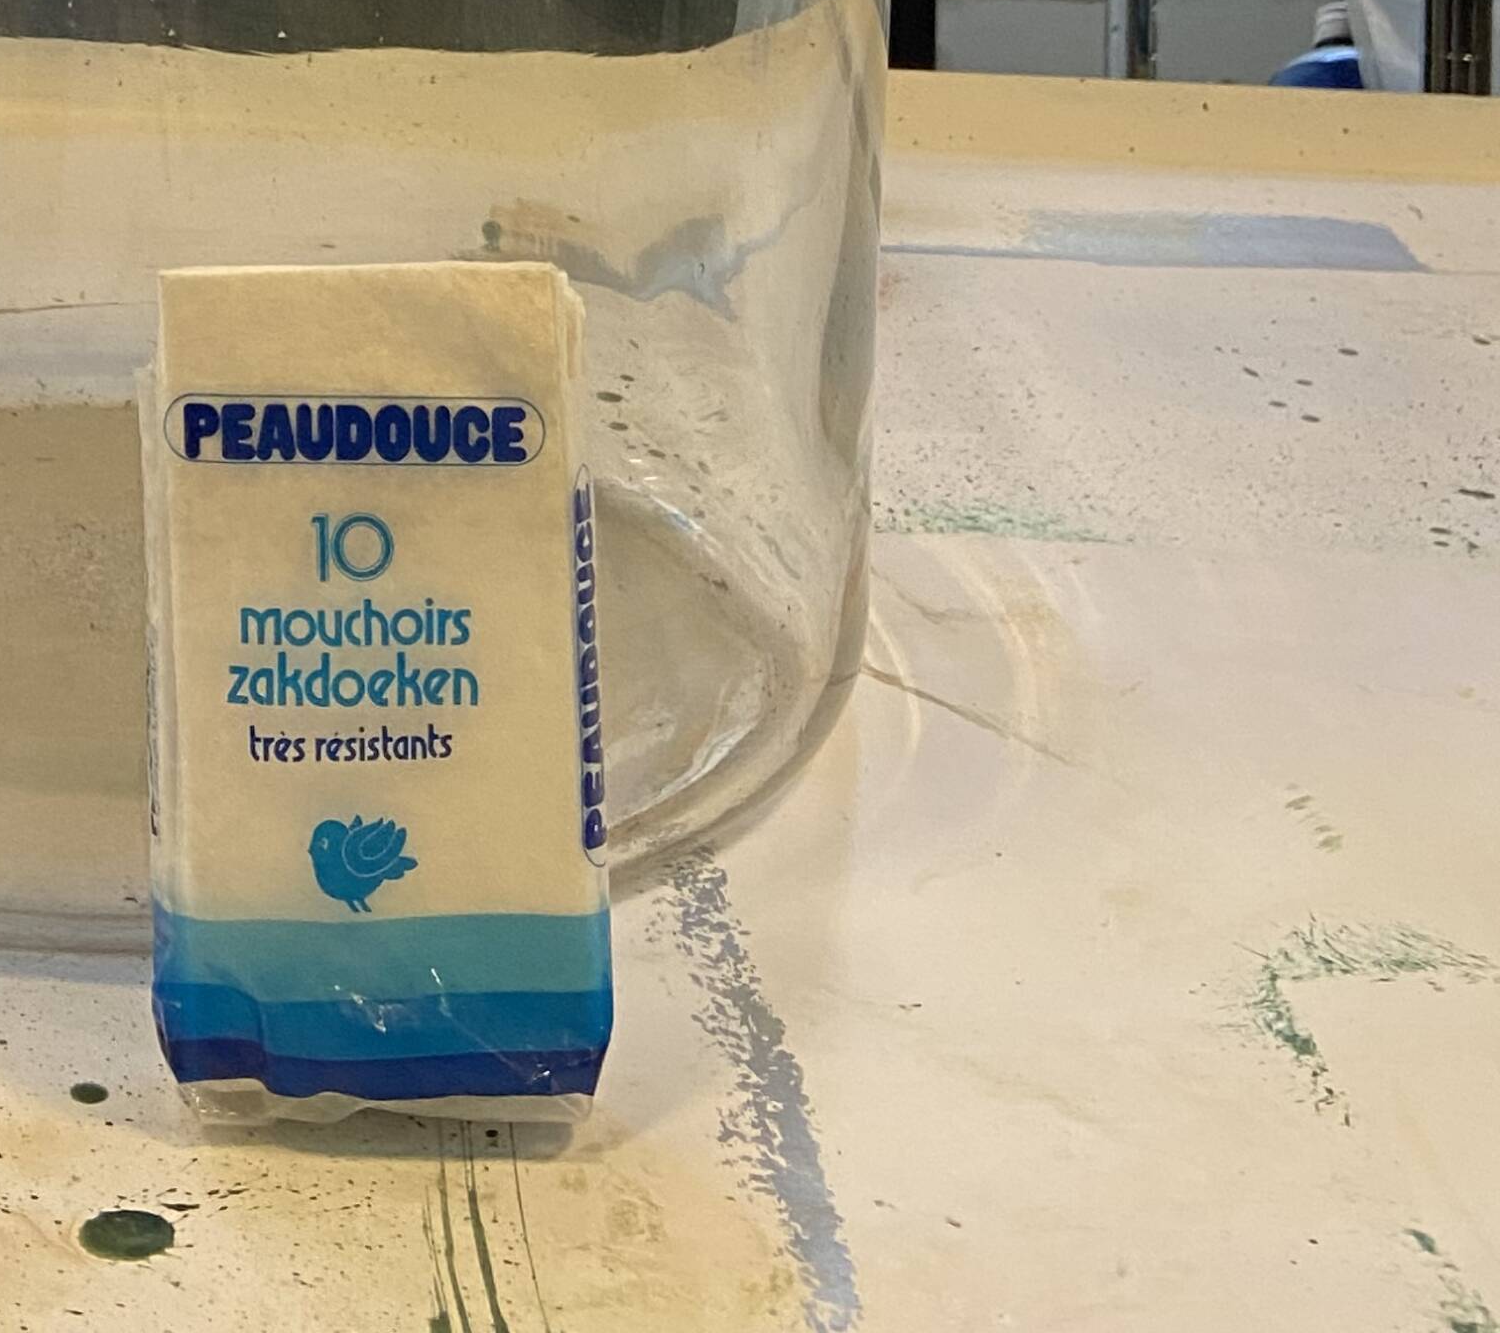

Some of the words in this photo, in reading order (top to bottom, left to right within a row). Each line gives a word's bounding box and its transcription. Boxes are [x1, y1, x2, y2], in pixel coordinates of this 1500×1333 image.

[183, 402, 528, 463] PEAUDOUCE
[311, 513, 395, 582] 10
[240, 598, 472, 647] mouchoirs
[227, 652, 479, 708] zakdoeken
[249, 725, 306, 763] très
[315, 723, 453, 763] résistants
